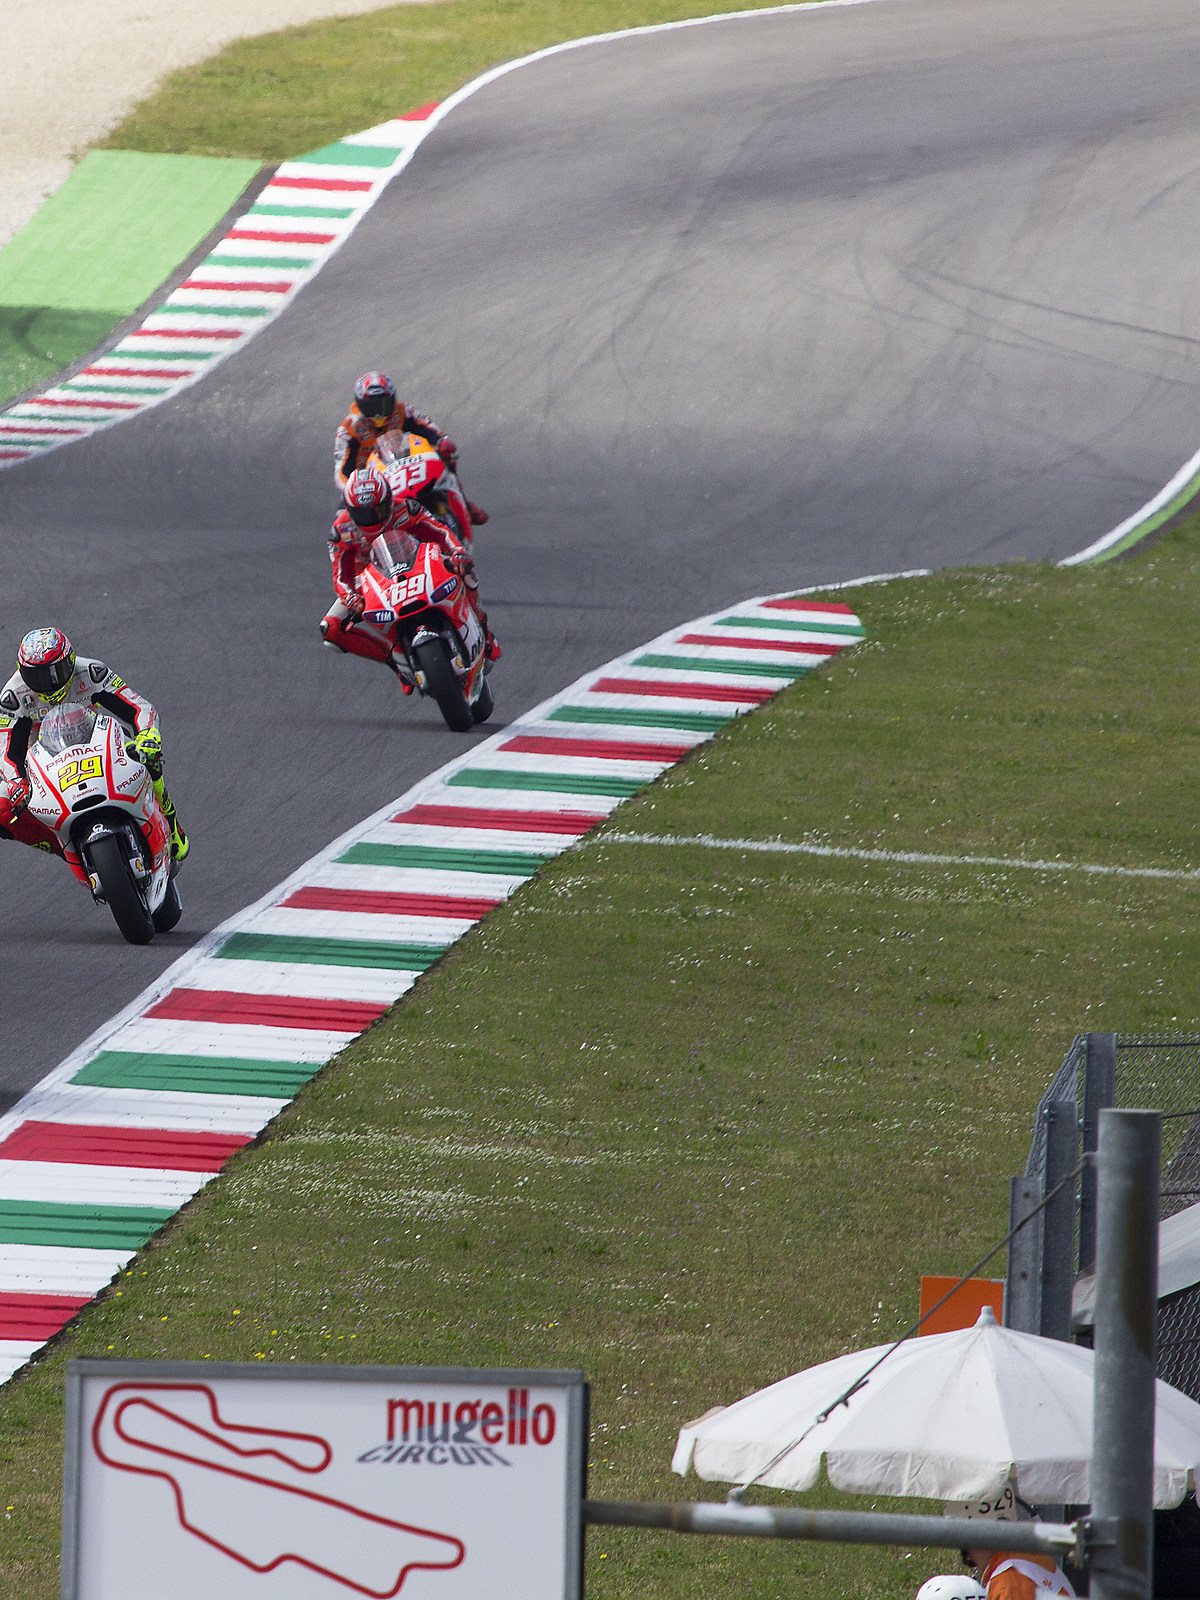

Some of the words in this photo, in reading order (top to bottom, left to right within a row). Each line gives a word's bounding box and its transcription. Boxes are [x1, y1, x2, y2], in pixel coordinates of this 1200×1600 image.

[389, 462, 426, 496] 93
[391, 574, 426, 607] 69
[443, 579, 457, 593] TIM
[375, 611, 392, 621] TIM
[46, 745, 104, 771] PRAMAC
[58, 755, 104, 793] 29
[116, 765, 145, 792] PRAMAC
[29, 806, 61, 815] PRAMAC
[387, 1388, 556, 1445] mugello
[357, 1444, 513, 1467] CIRCUIT
